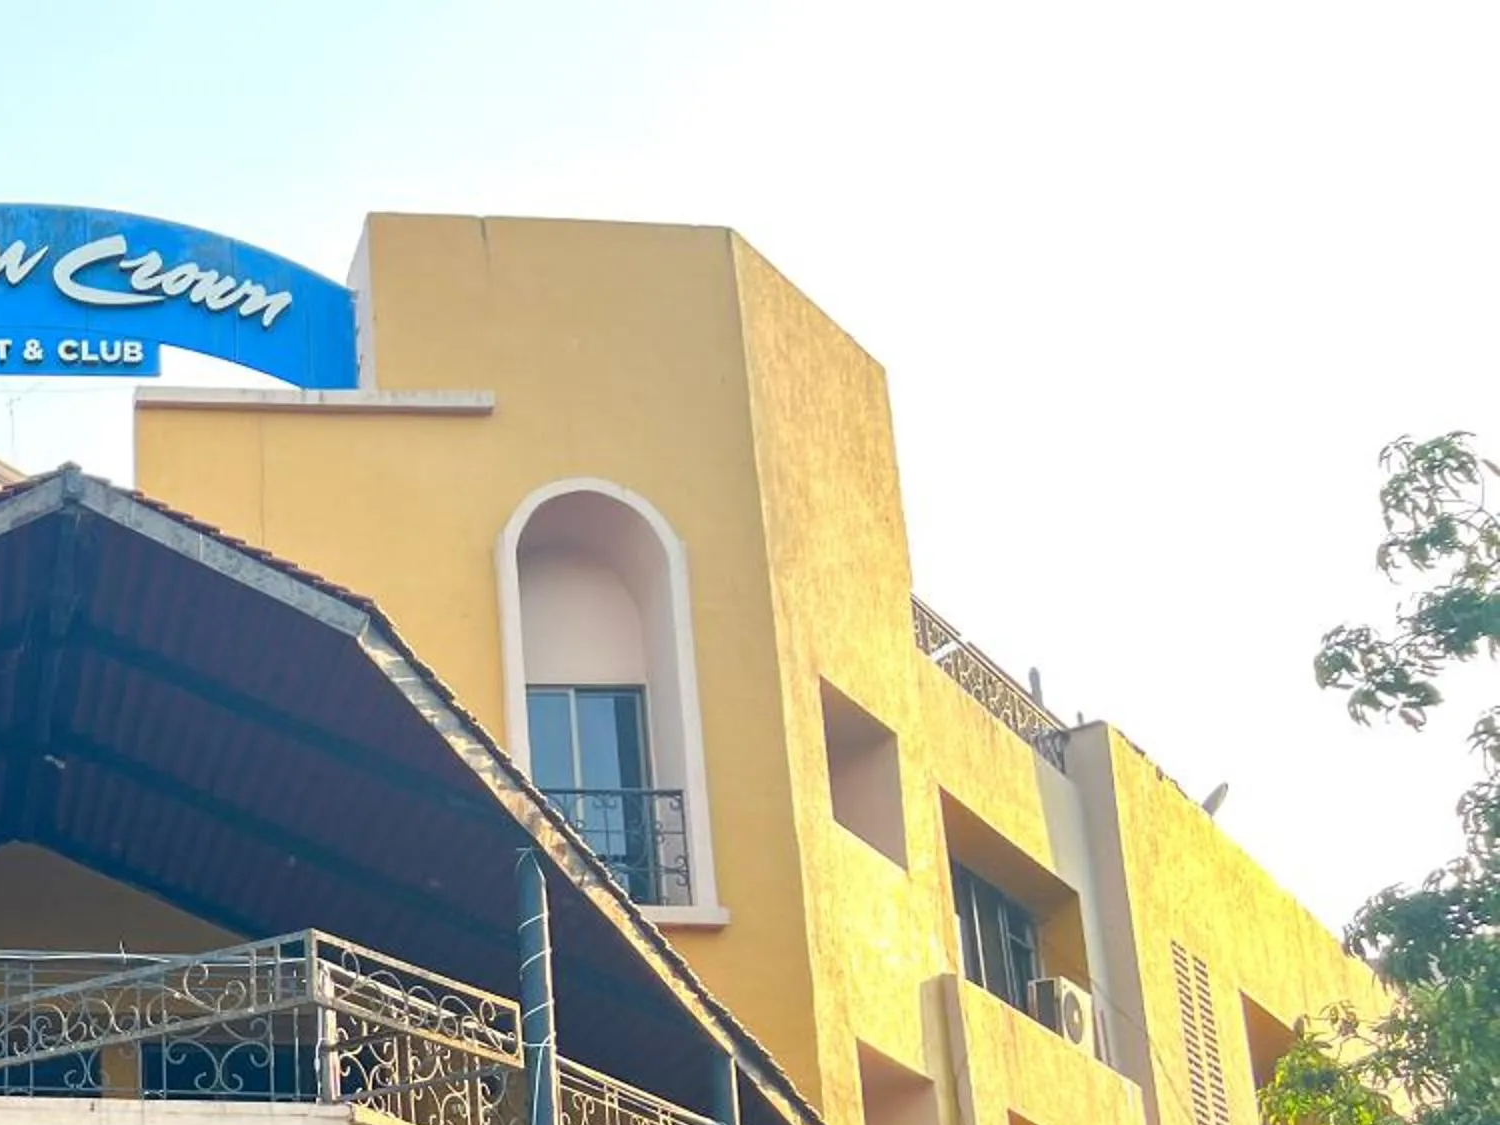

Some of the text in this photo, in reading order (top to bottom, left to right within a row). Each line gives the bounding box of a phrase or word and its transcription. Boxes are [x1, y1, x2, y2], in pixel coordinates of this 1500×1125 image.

[53, 235, 293, 327] Crown
[23, 339, 43, 362] &
[57, 340, 144, 363] CLUB
